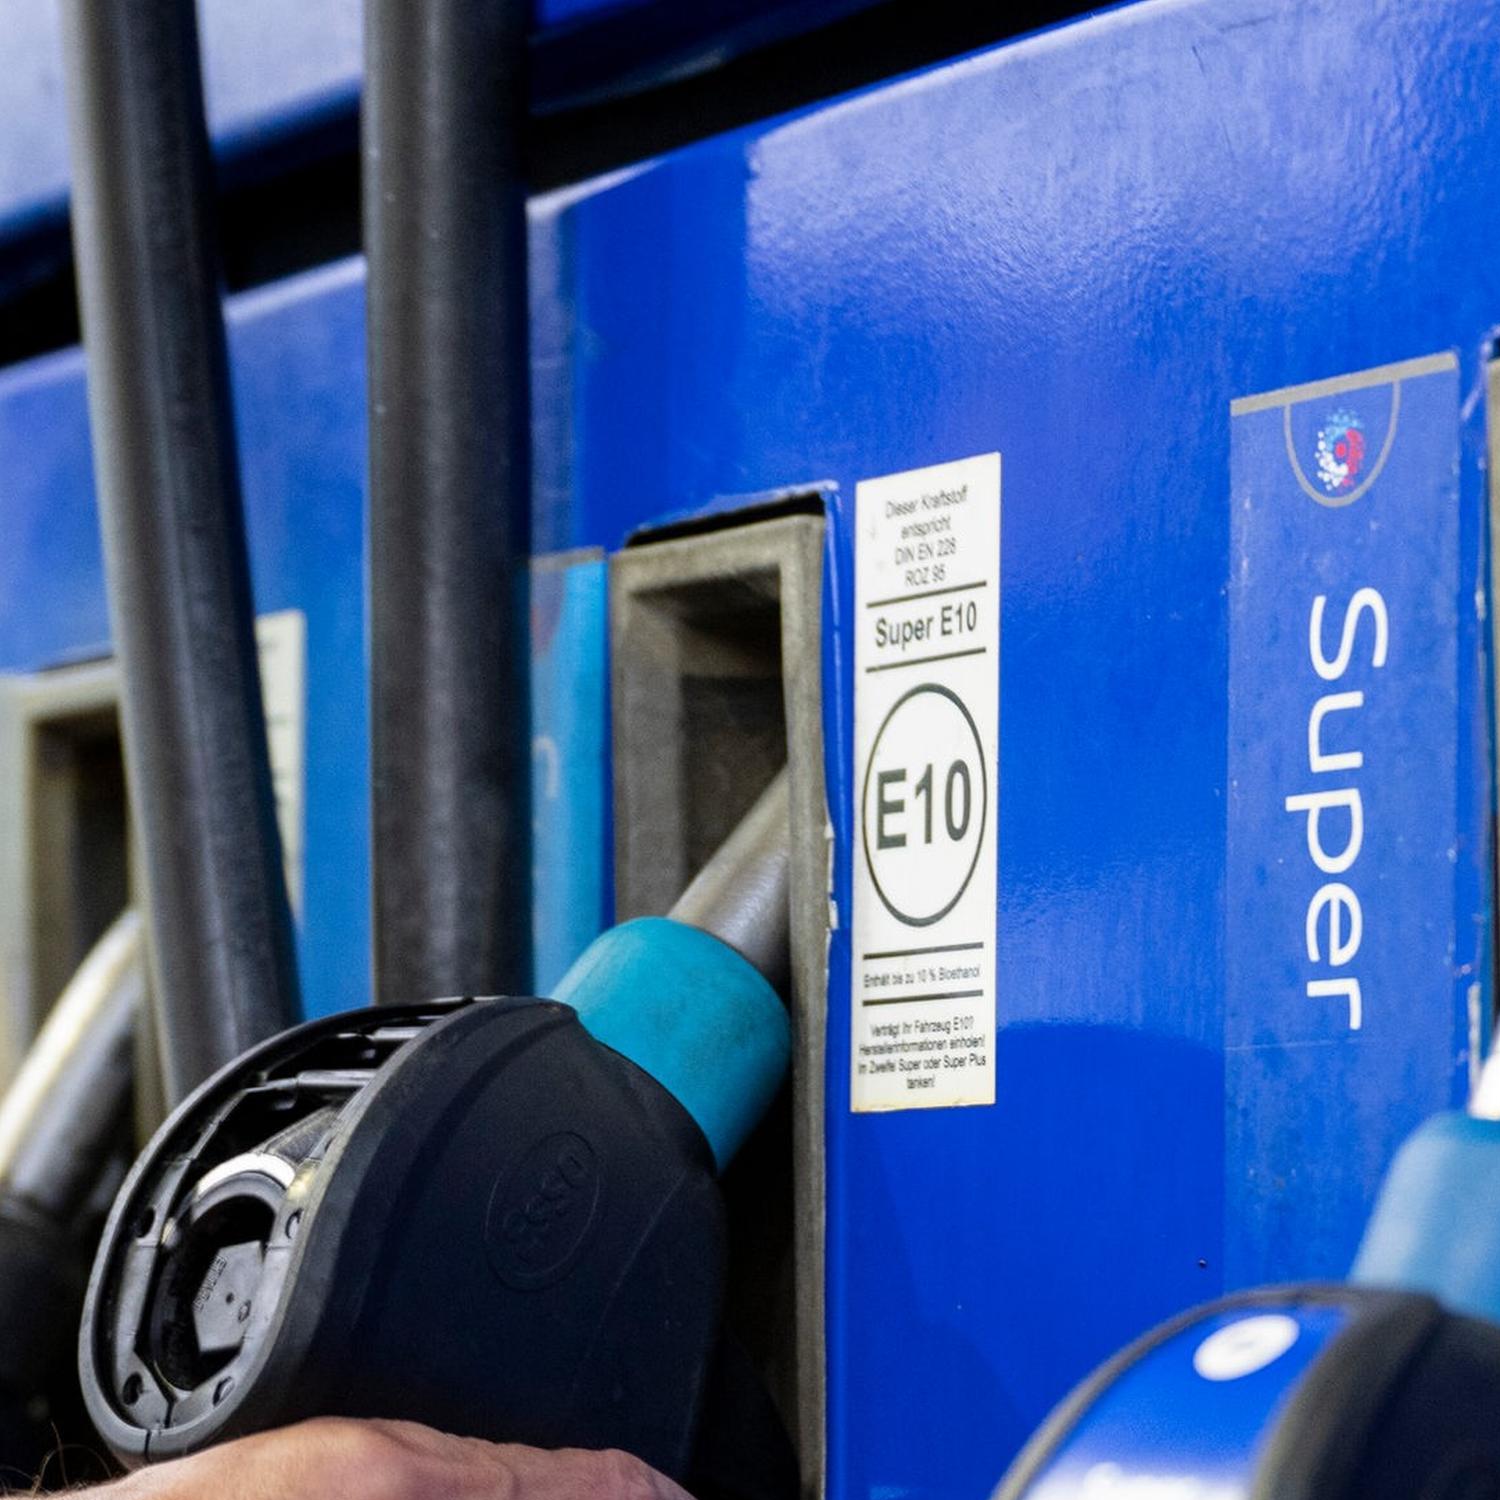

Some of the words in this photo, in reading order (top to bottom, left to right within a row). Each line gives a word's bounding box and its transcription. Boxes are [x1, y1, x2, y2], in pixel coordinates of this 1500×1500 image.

[876, 617, 933, 651] Super
[940, 601, 977, 636] E10
[877, 759, 971, 850] E10
[1286, 587, 1389, 1030] Super
[899, 1058, 921, 1072] Super
[943, 1054, 967, 1069] Super
[969, 1052, 987, 1067] Plus
